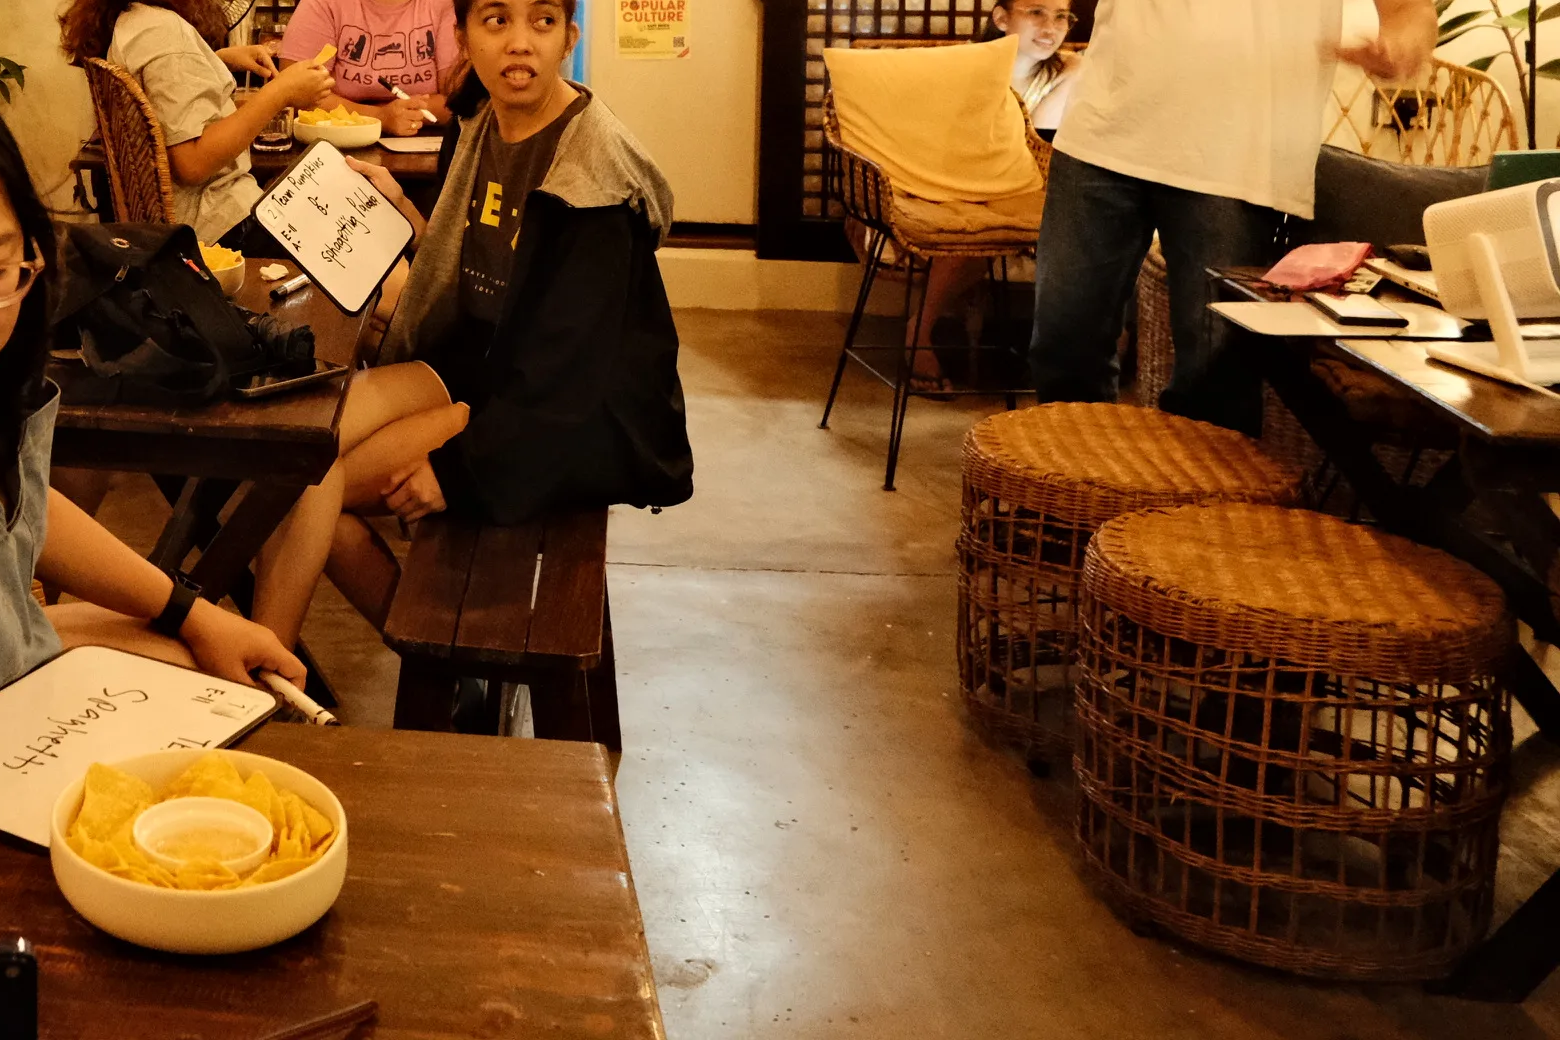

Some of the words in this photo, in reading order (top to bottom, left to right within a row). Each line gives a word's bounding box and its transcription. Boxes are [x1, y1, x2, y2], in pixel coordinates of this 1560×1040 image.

[621, 0, 685, 11] POPULAR
[623, 11, 683, 22] CULTURE
[342, 68, 373, 85] LAS
[271, 189, 295, 207] Team
[287, 157, 324, 191] Pumpkins
[267, 209, 278, 220] 2
[2, 687, 149, 775] Spaghetti
